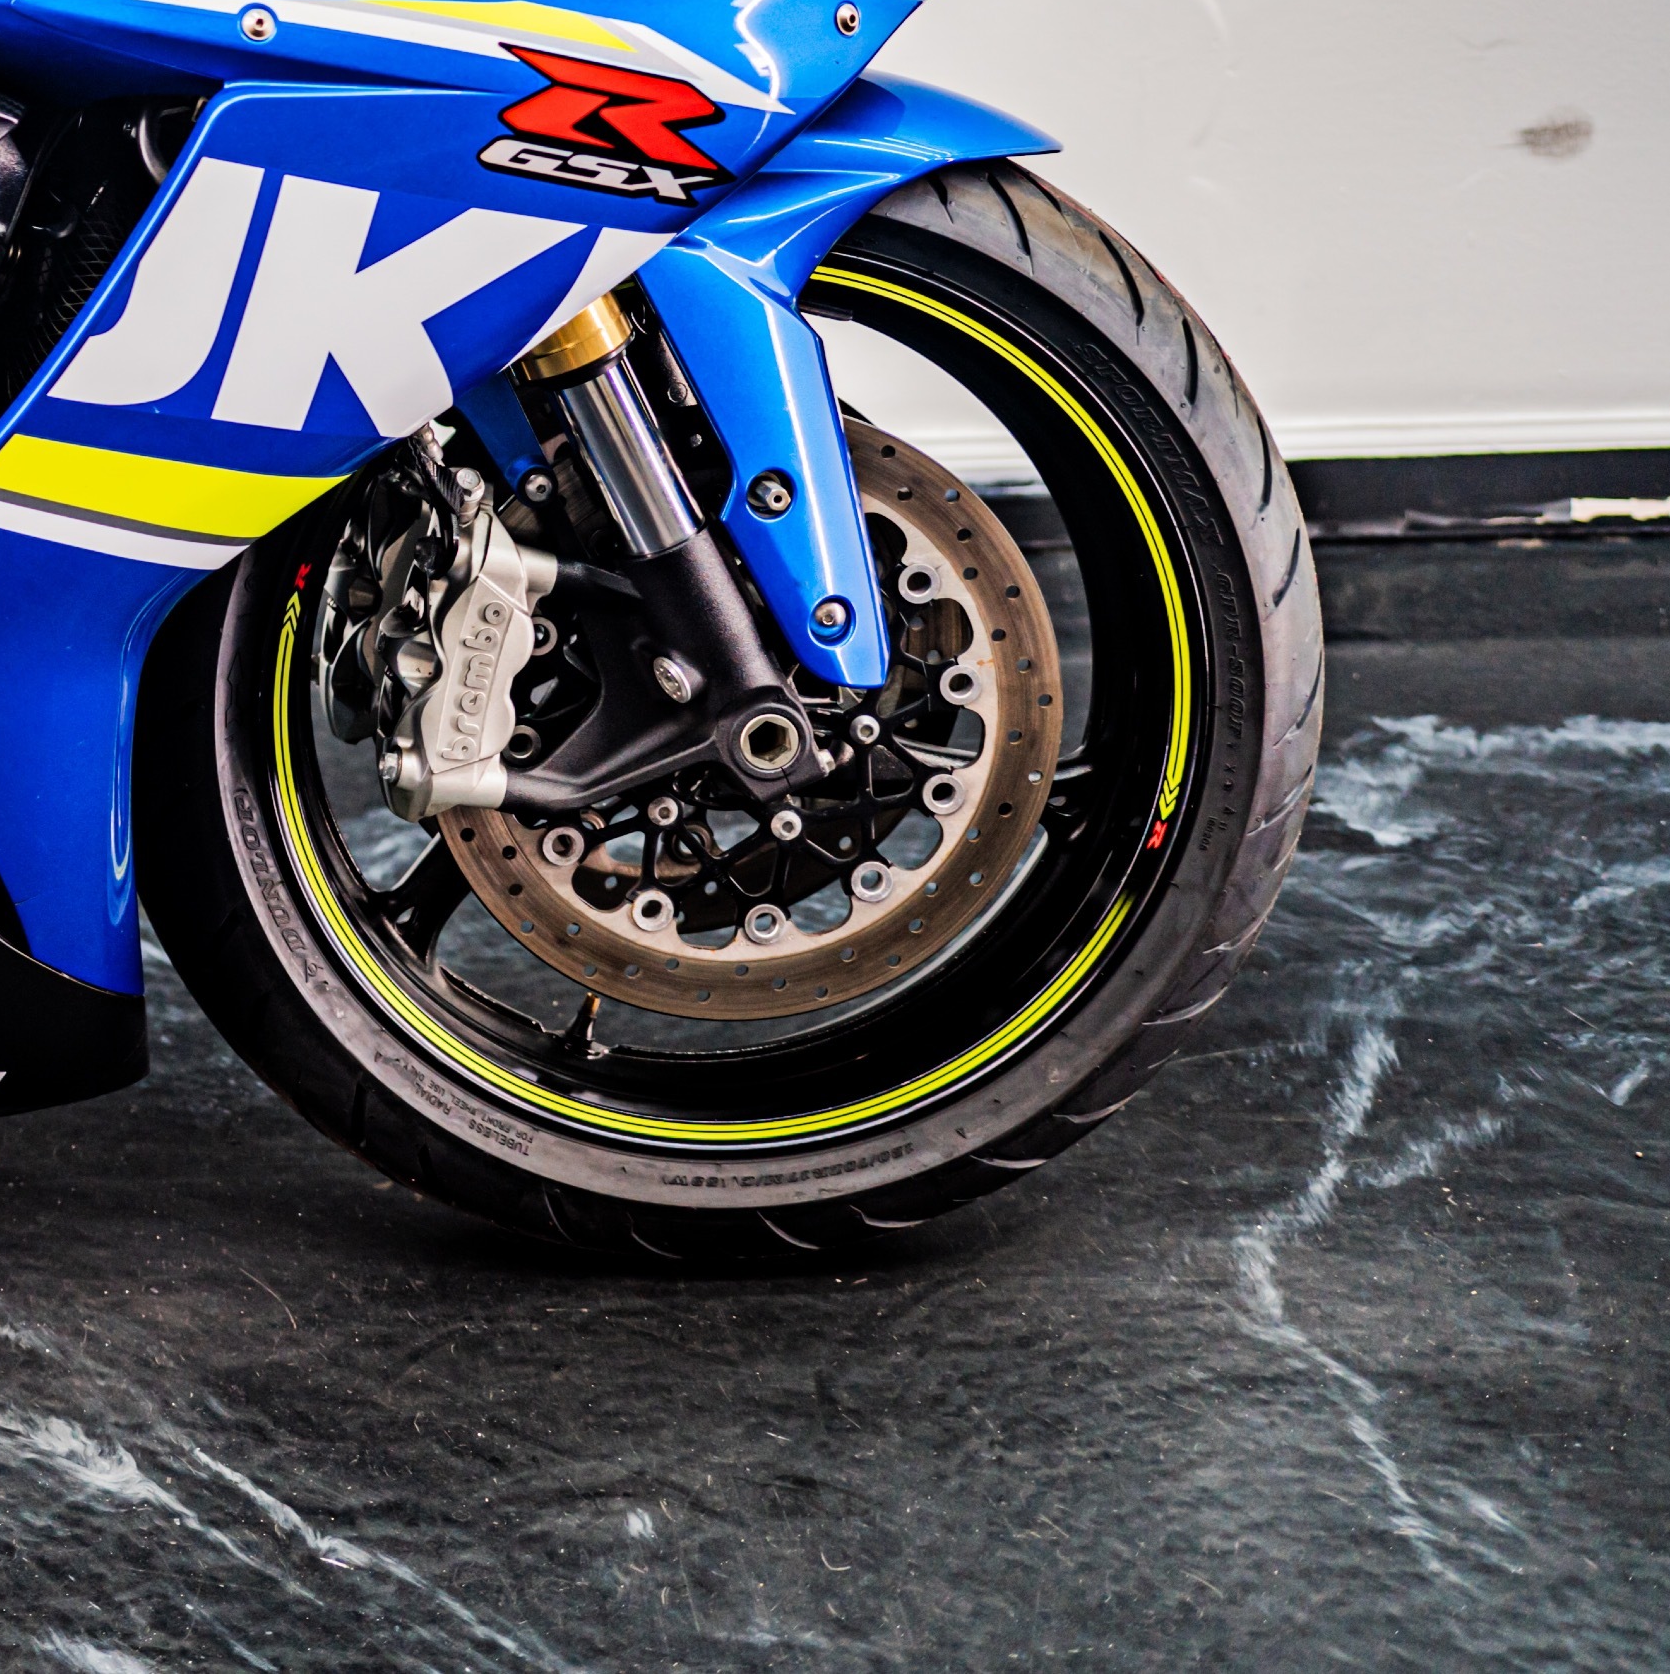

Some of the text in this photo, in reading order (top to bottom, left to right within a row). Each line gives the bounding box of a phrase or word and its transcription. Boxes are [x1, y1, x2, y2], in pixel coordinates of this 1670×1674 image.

[477, 137, 717, 202] GSX
[499, 43, 727, 176] R
[1070, 334, 1225, 552] SPORTMAX
[440, 601, 509, 761] brembo
[227, 787, 310, 957] DUNLOP
[409, 1080, 532, 1157] TUBELESS RADIAL
[479, 1111, 512, 1134] FRONT
